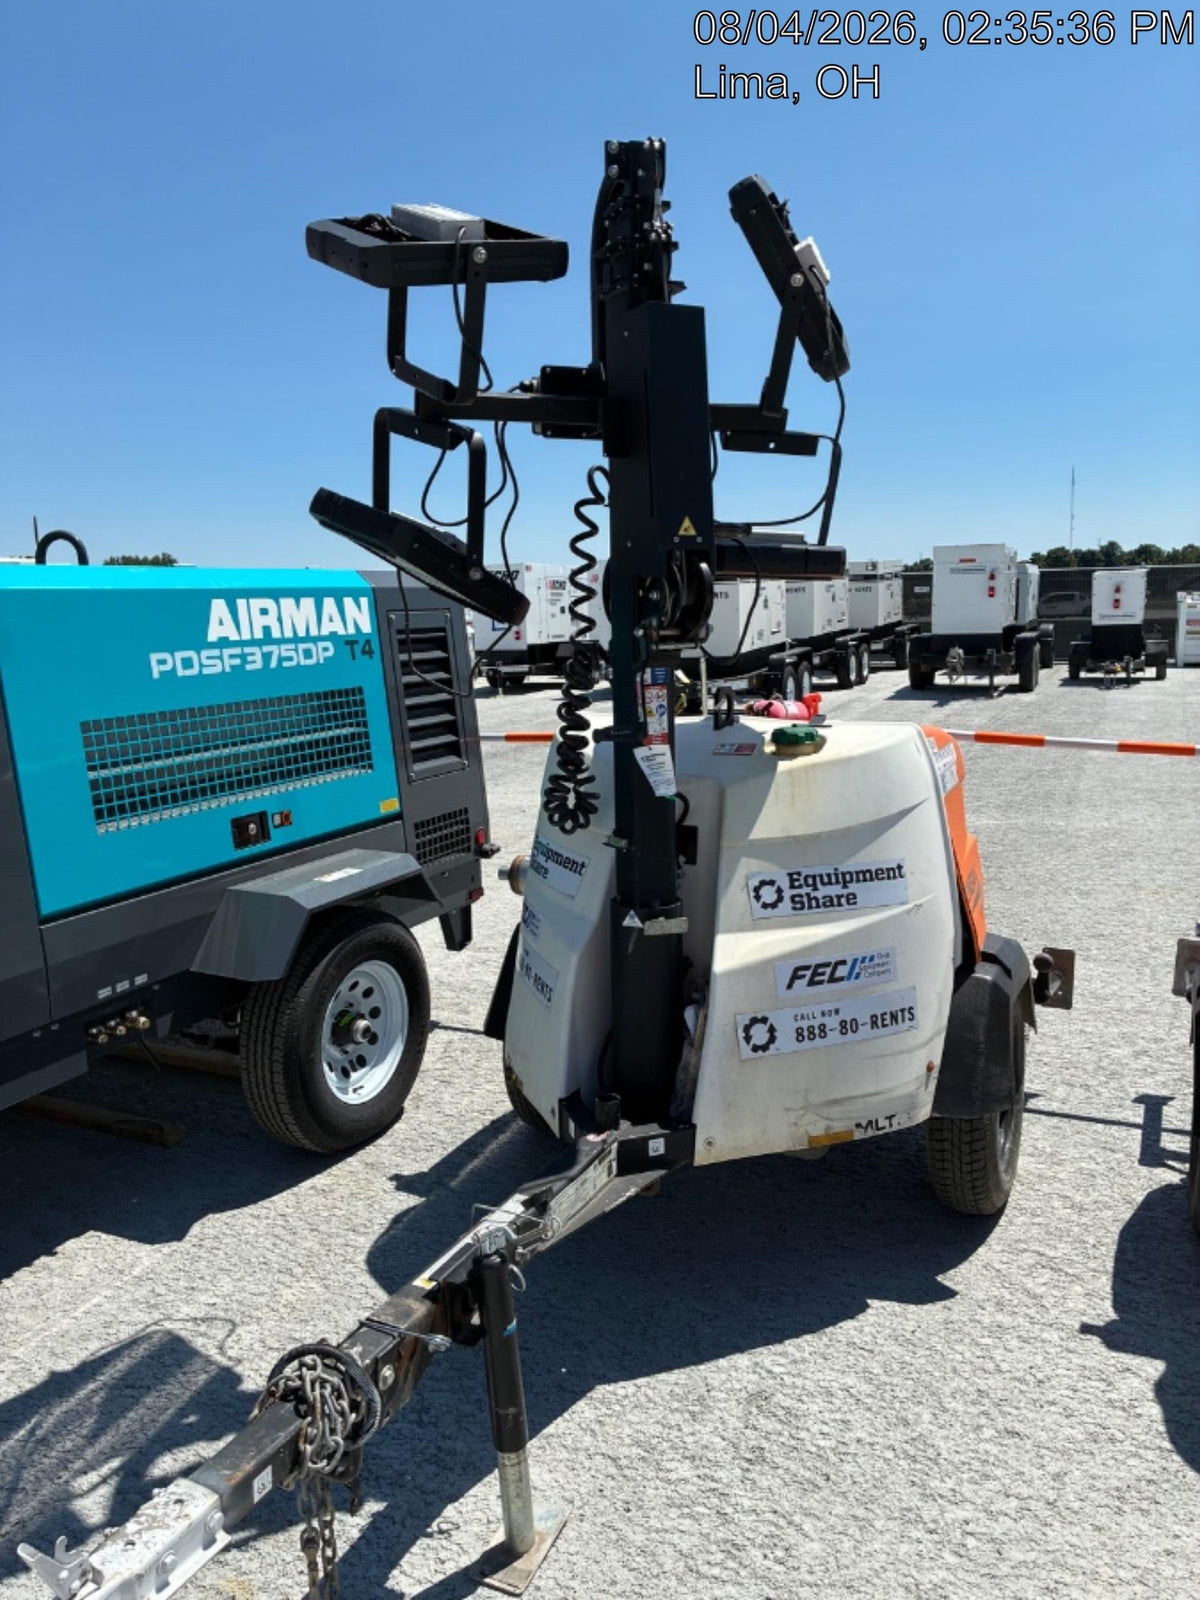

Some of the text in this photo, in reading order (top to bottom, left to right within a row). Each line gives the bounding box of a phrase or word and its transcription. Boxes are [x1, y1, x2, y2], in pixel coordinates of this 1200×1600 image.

[207, 597, 372, 642] AIRMAN
[344, 639, 375, 661] T4
[786, 862, 905, 892] Equipment
[790, 892, 858, 911] Share
[786, 959, 848, 991] FEC
[793, 1007, 841, 1022] CALL NOW
[795, 1006, 916, 1043] 888-80-RENTS
